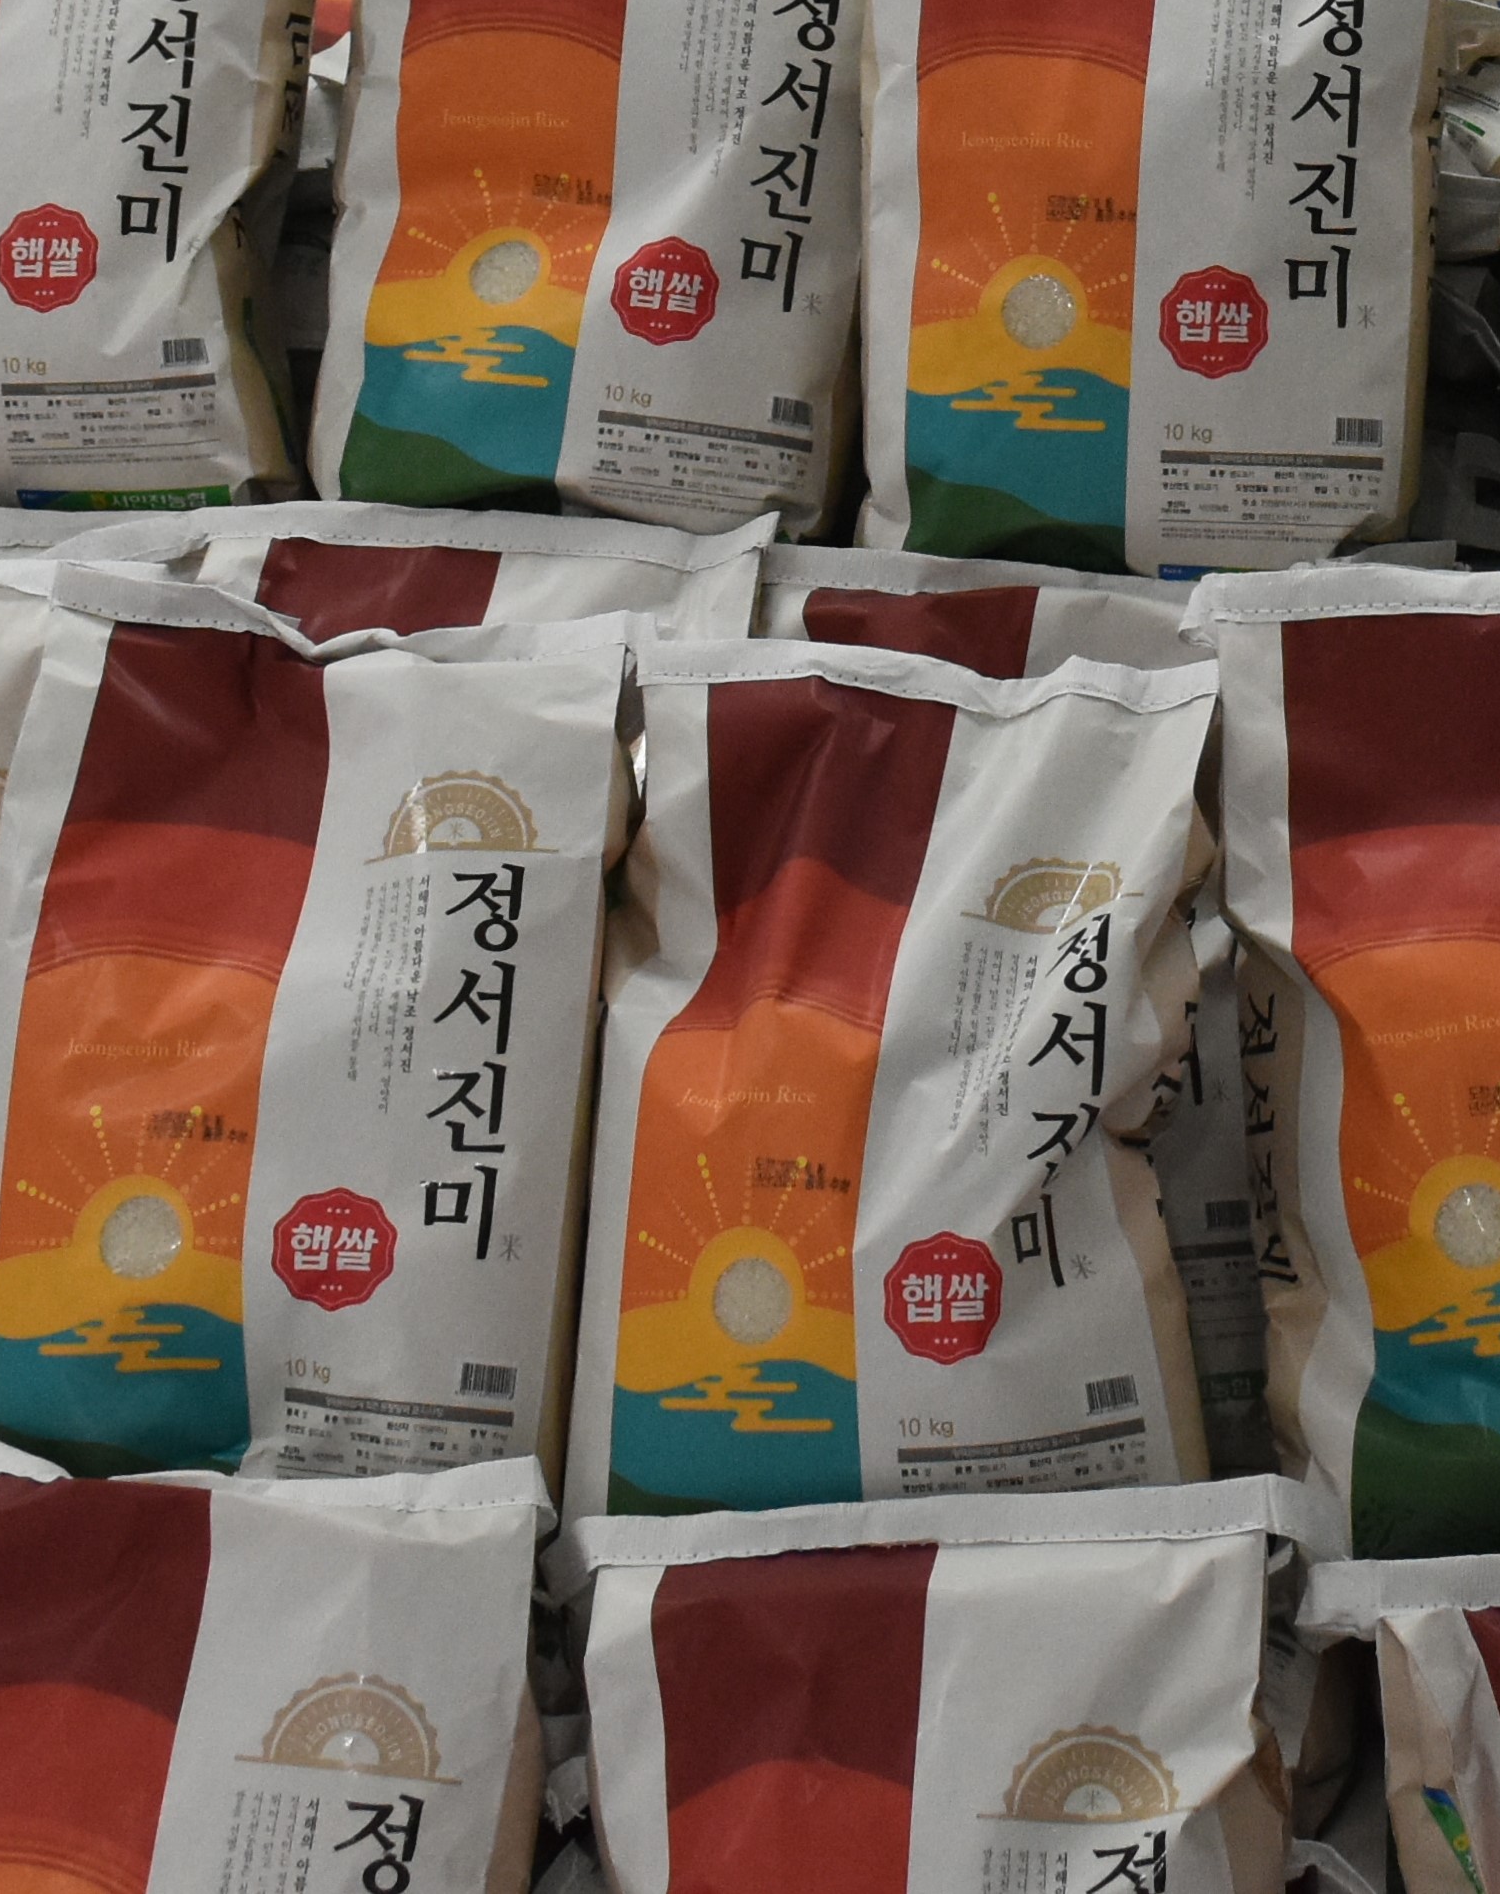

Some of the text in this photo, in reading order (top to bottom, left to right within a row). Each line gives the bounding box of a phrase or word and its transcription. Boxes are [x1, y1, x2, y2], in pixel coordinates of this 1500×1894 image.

[10, 235, 82, 279] 햅쌀
[628, 265, 705, 313] 햅쌀
[1175, 298, 1254, 345] 햅쌀
[2, 357, 47, 375] 10 kg
[604, 383, 653, 409] 10 kg
[1164, 423, 1213, 444] 10 kg
[417, 873, 431, 918] 서해의
[403, 988, 418, 1019] 낙조
[175, 1042, 215, 1060] Rice
[400, 1025, 414, 1074] 정서진
[420, 863, 525, 1261] 정서진미
[289, 1223, 379, 1274] 햅쌀
[900, 1268, 991, 1325] 햅쌀
[284, 1359, 332, 1385] 10 kg
[928, 1416, 956, 1442] kg
[333, 1794, 425, 1894] 정
